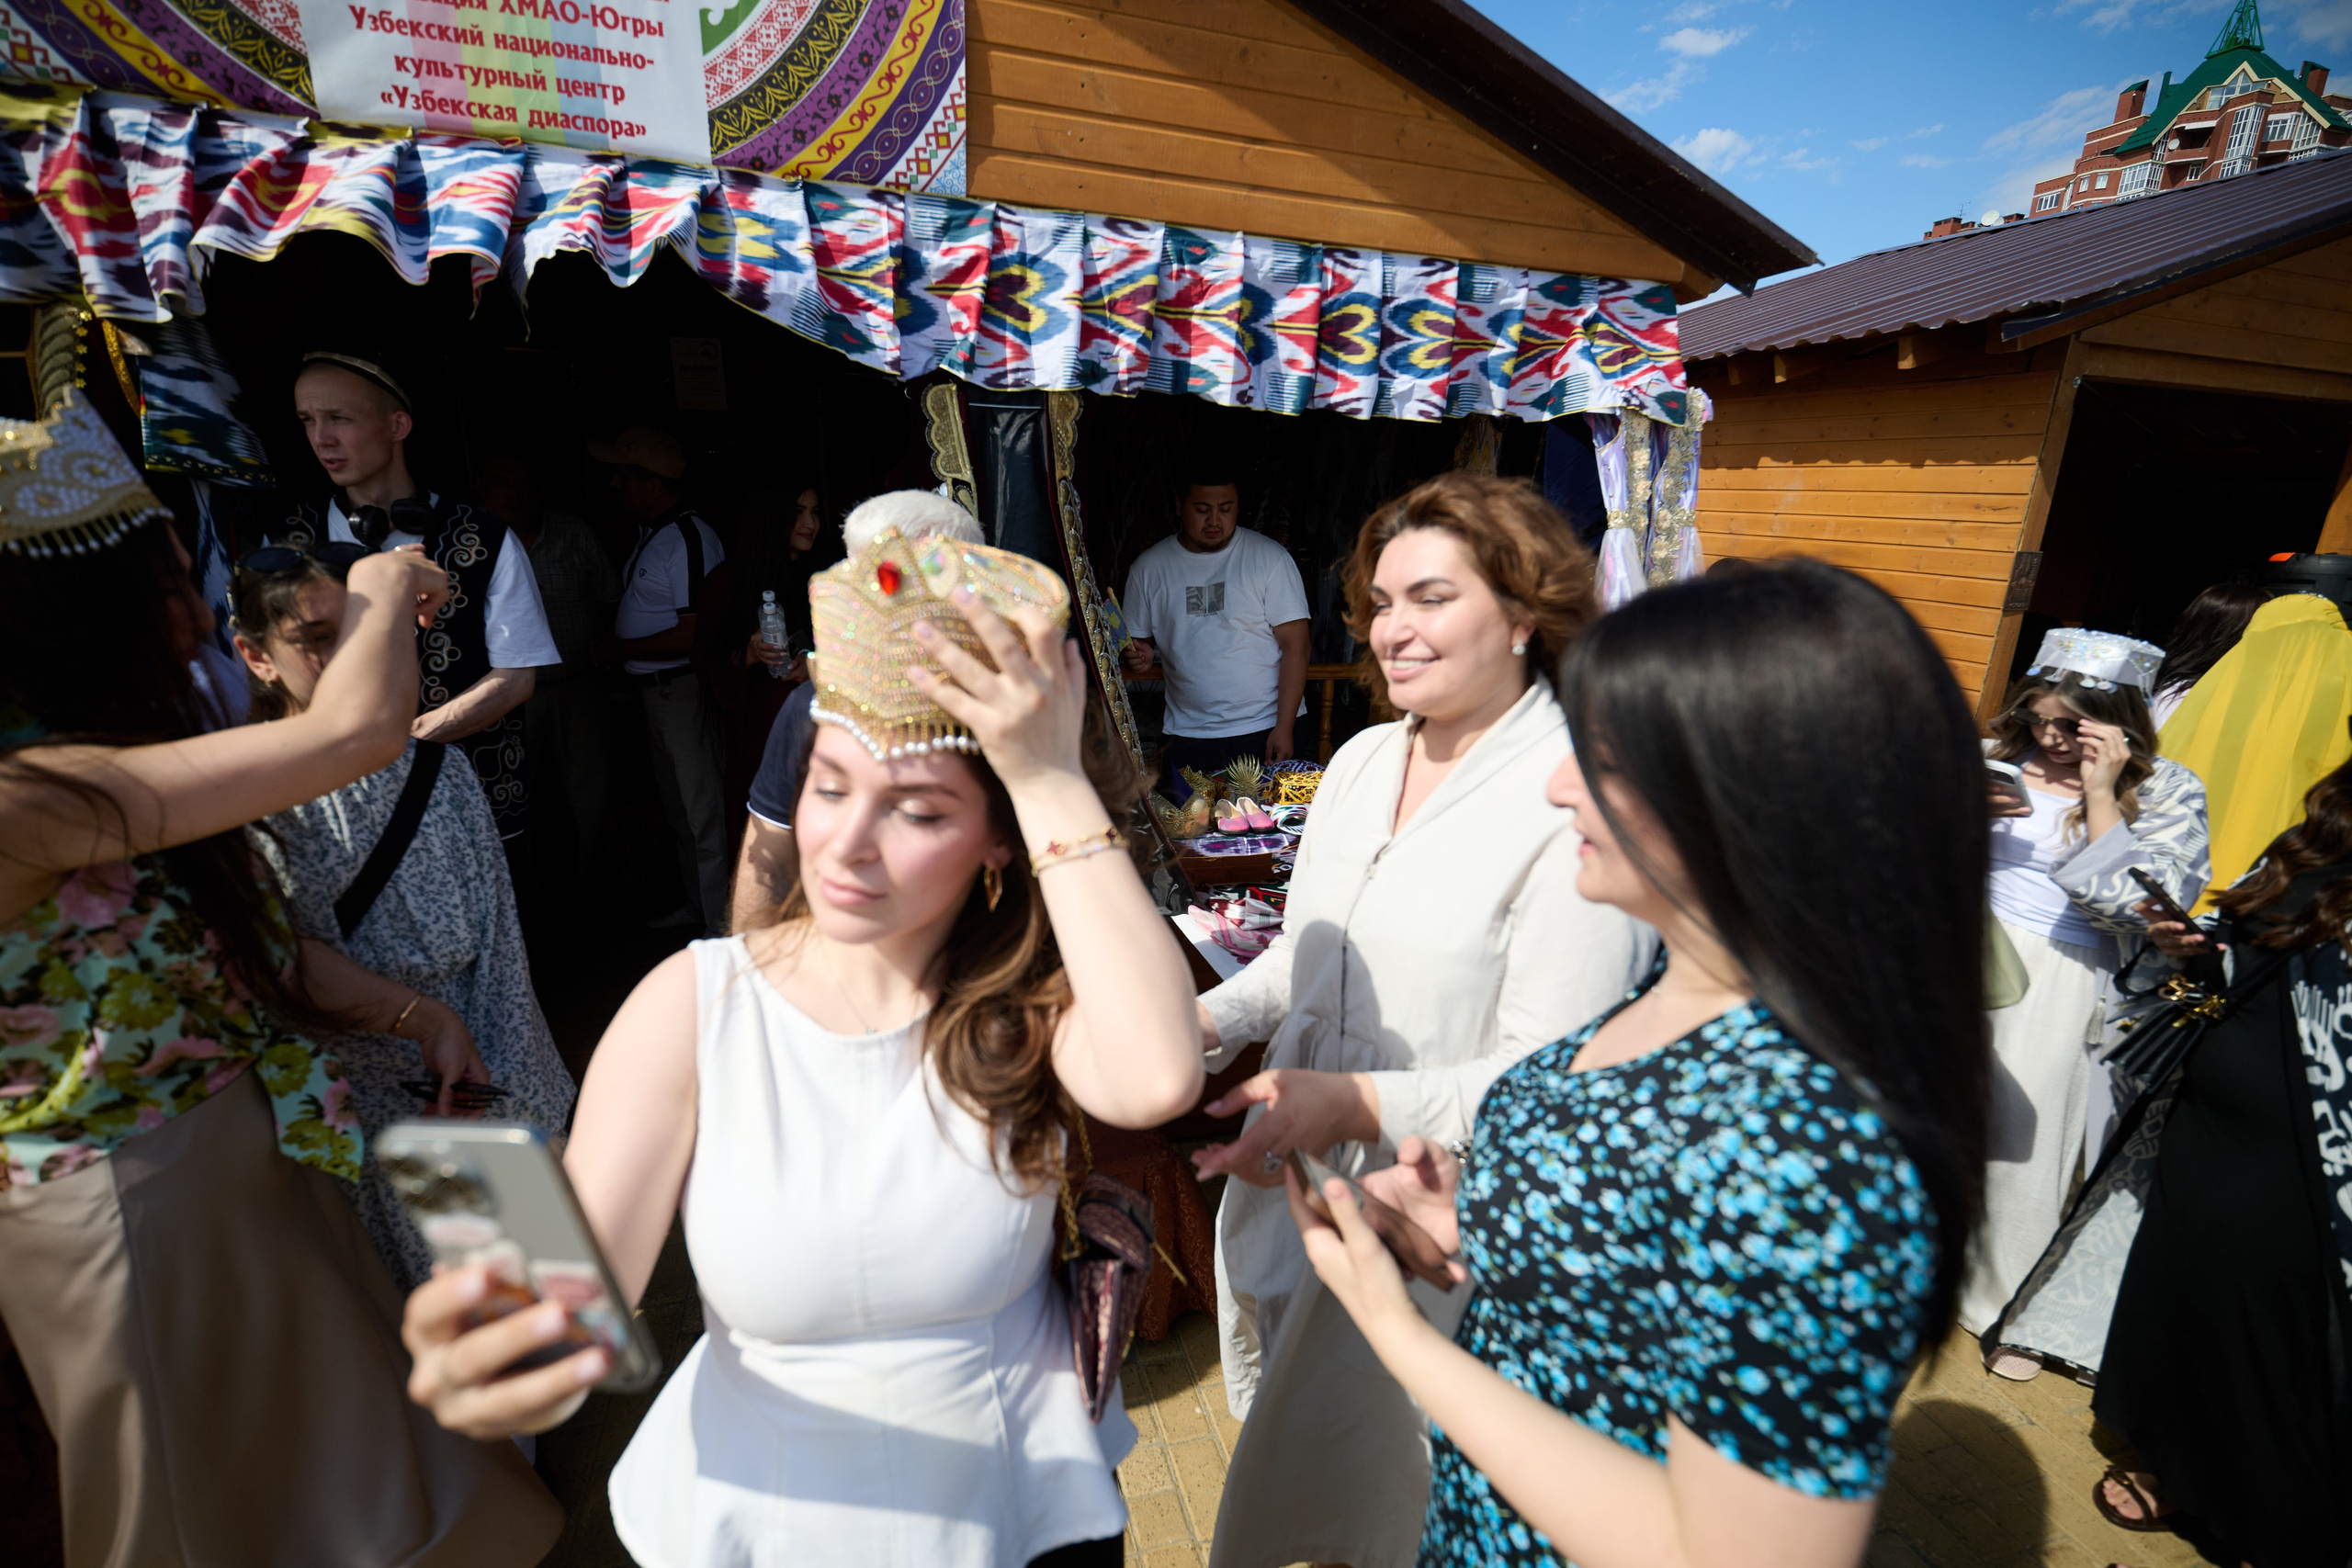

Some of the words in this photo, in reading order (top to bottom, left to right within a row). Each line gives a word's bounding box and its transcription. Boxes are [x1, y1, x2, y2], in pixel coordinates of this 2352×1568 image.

[348, 5, 485, 47] Узбекский
[493, 32, 654, 70] национально-
[499, 0, 664, 38] ХМАО-Югры
[394, 55, 548, 92] культурный
[555, 77, 626, 106] центр
[380, 85, 518, 123] «Узбекская
[527, 109, 647, 140] диаспора»
